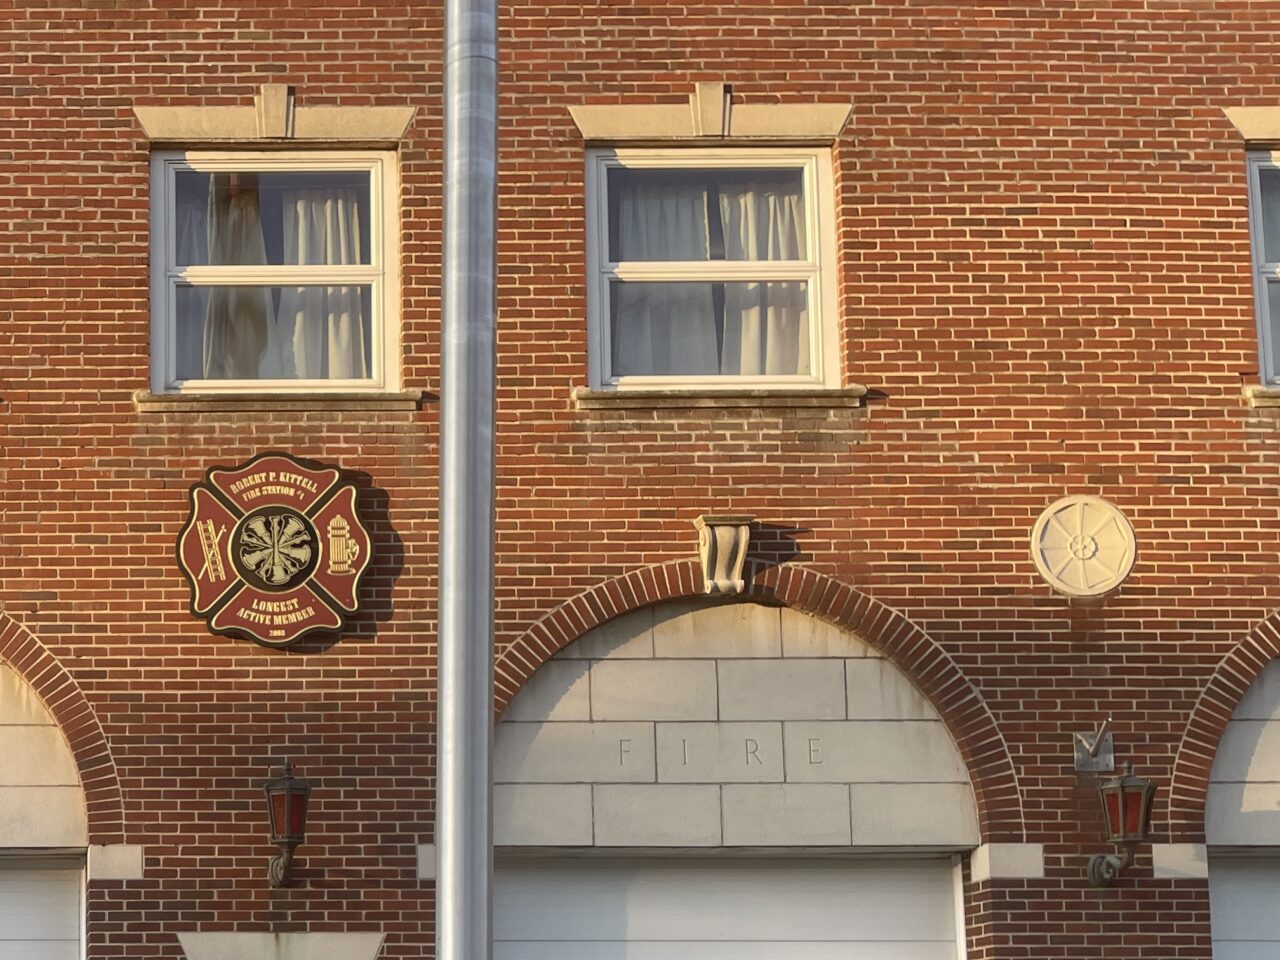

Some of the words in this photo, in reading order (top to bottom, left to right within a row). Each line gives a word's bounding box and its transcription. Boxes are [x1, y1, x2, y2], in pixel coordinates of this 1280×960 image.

[229, 471, 267, 494] ROBERT
[279, 471, 318, 494] KITTELL
[242, 487, 261, 502] FIRE
[261, 485, 296, 497] STATION
[251, 597, 299, 613] LONGEST
[236, 607, 272, 625] ACTIVE
[273, 606, 316, 626] MEMBER
[619, 738, 824, 766] FIRE
